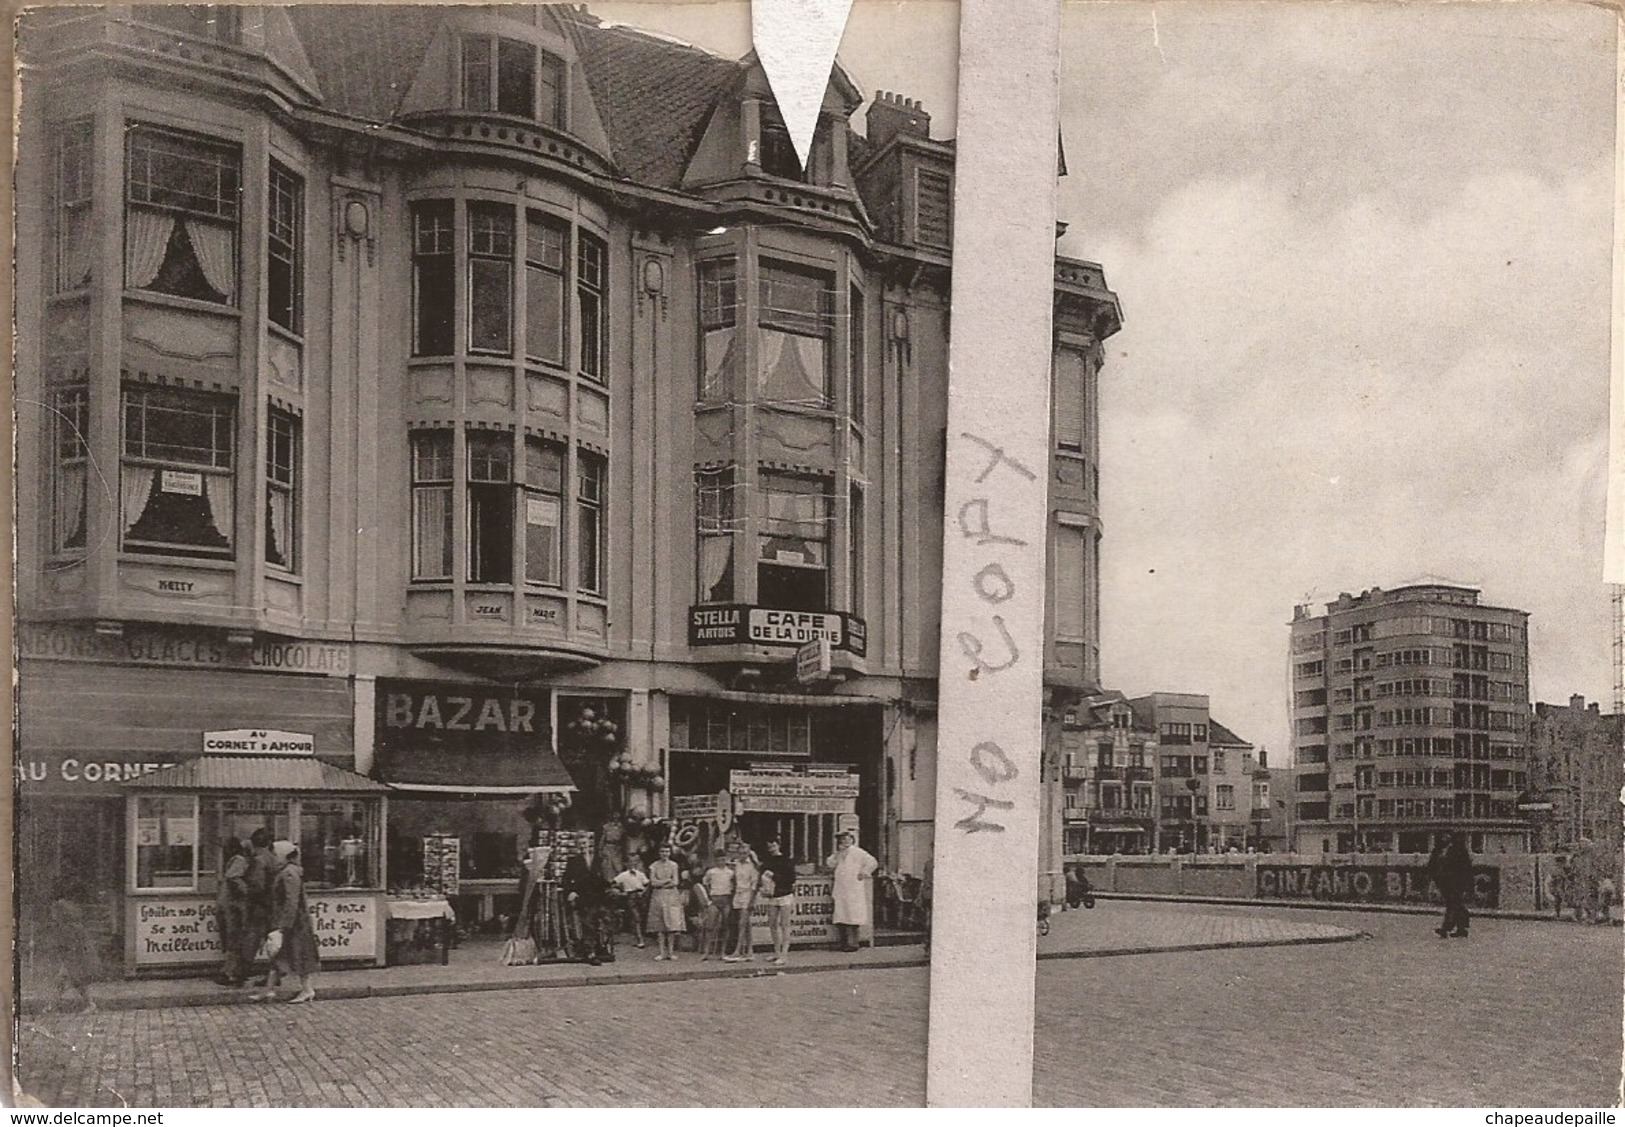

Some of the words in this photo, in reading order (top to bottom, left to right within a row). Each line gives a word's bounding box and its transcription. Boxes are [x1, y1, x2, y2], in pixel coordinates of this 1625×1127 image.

[957, 433, 1036, 676] COPY
[475, 606, 502, 614] JEAN
[693, 610, 741, 626] STELLA
[766, 612, 825, 628] CAFE
[697, 626, 736, 639] ARTOIS
[752, 626, 771, 638] DE
[776, 627, 793, 640] LA
[797, 628, 839, 643] DIGUE
[129, 637, 222, 663] GLACES
[251, 642, 348, 669] CHOCOLATS
[386, 692, 535, 733] BAZAR
[206, 739, 257, 750] CORNET
[61, 759, 176, 782] CORNE
[952, 740, 1019, 834] NO
[1259, 867, 1374, 896] CINZANO
[1385, 871, 1493, 903] BLAC
[171, 921, 200, 934] sont
